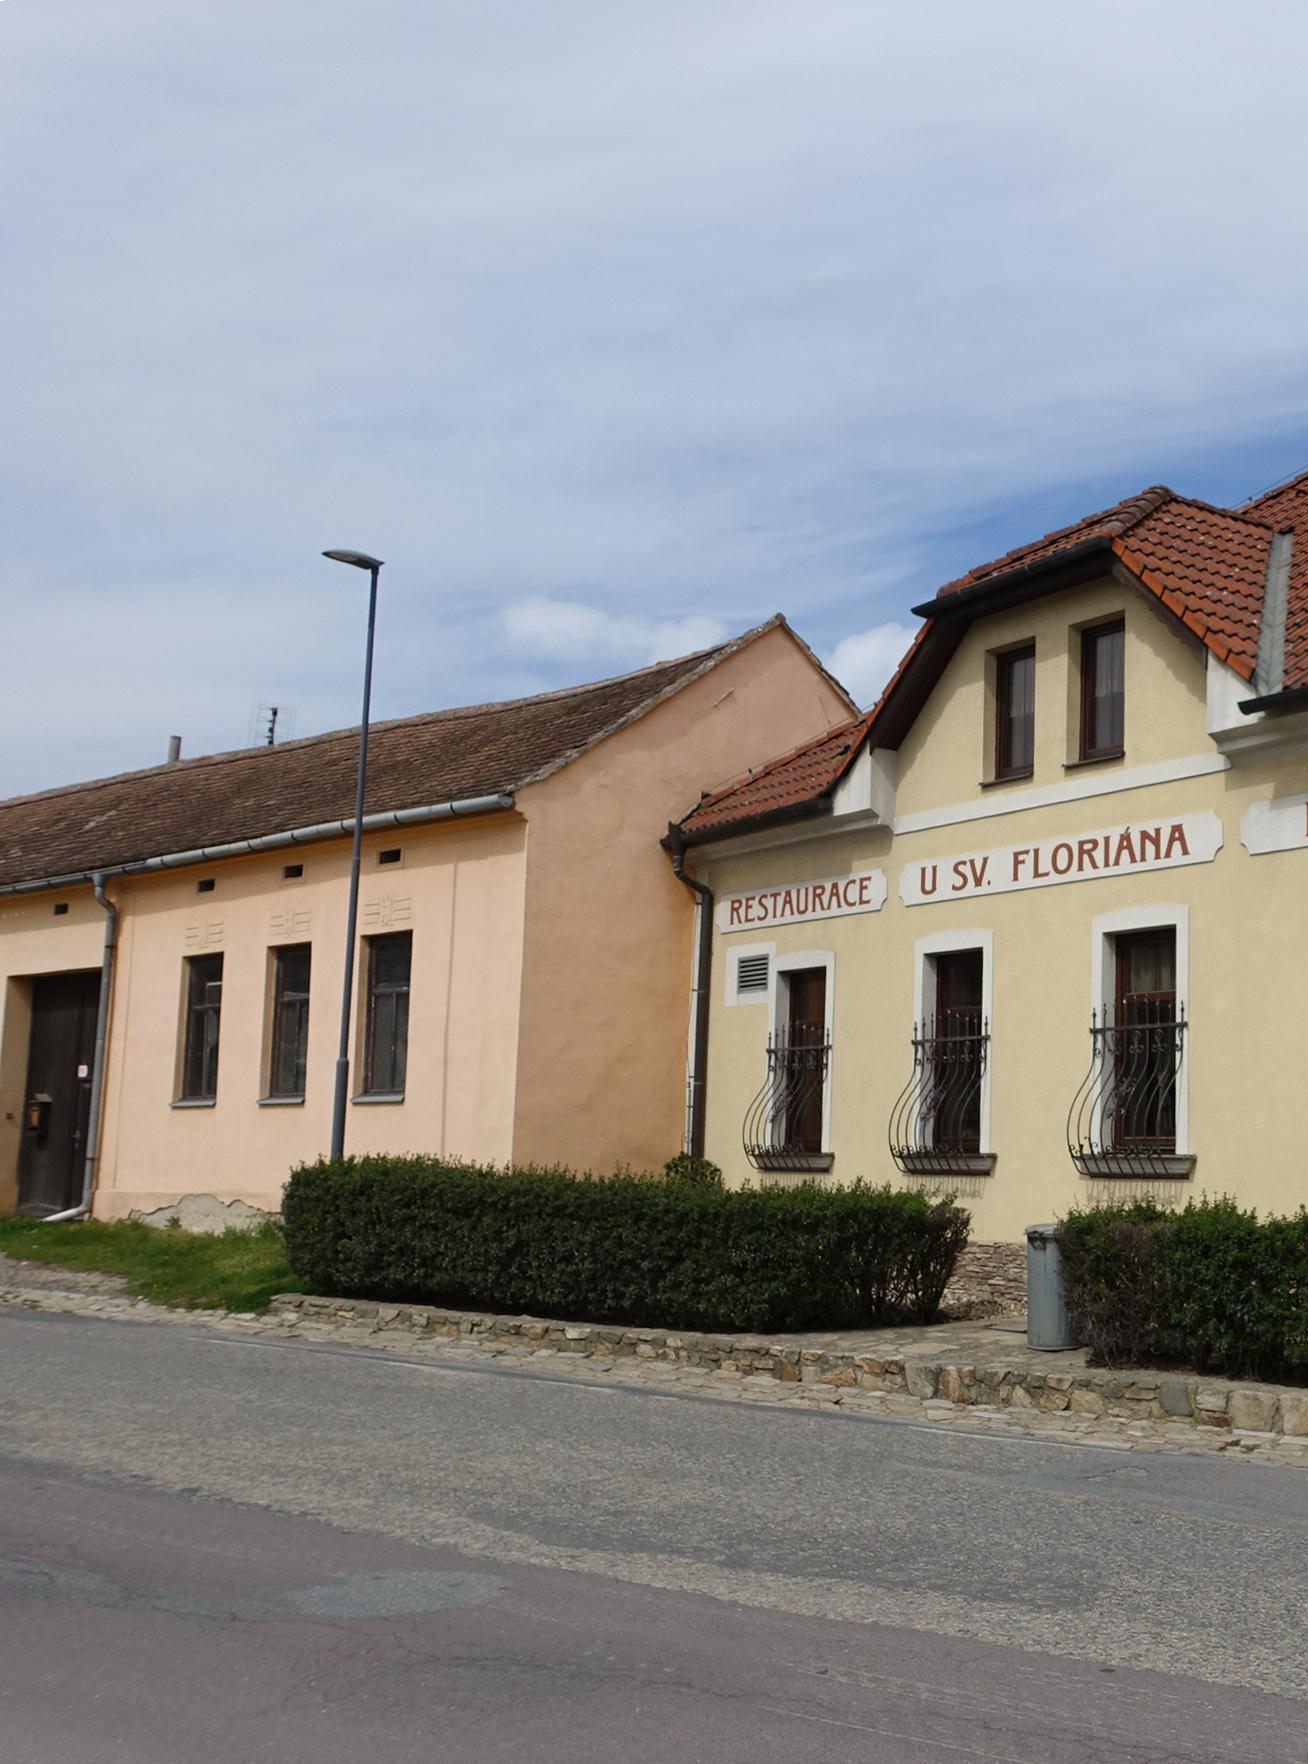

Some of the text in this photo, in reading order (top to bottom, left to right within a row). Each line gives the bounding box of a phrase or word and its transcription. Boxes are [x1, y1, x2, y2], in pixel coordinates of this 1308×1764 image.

[920, 823, 1190, 895] U SV. FLORIÁNA
[729, 876, 872, 925] RESTAURACE
